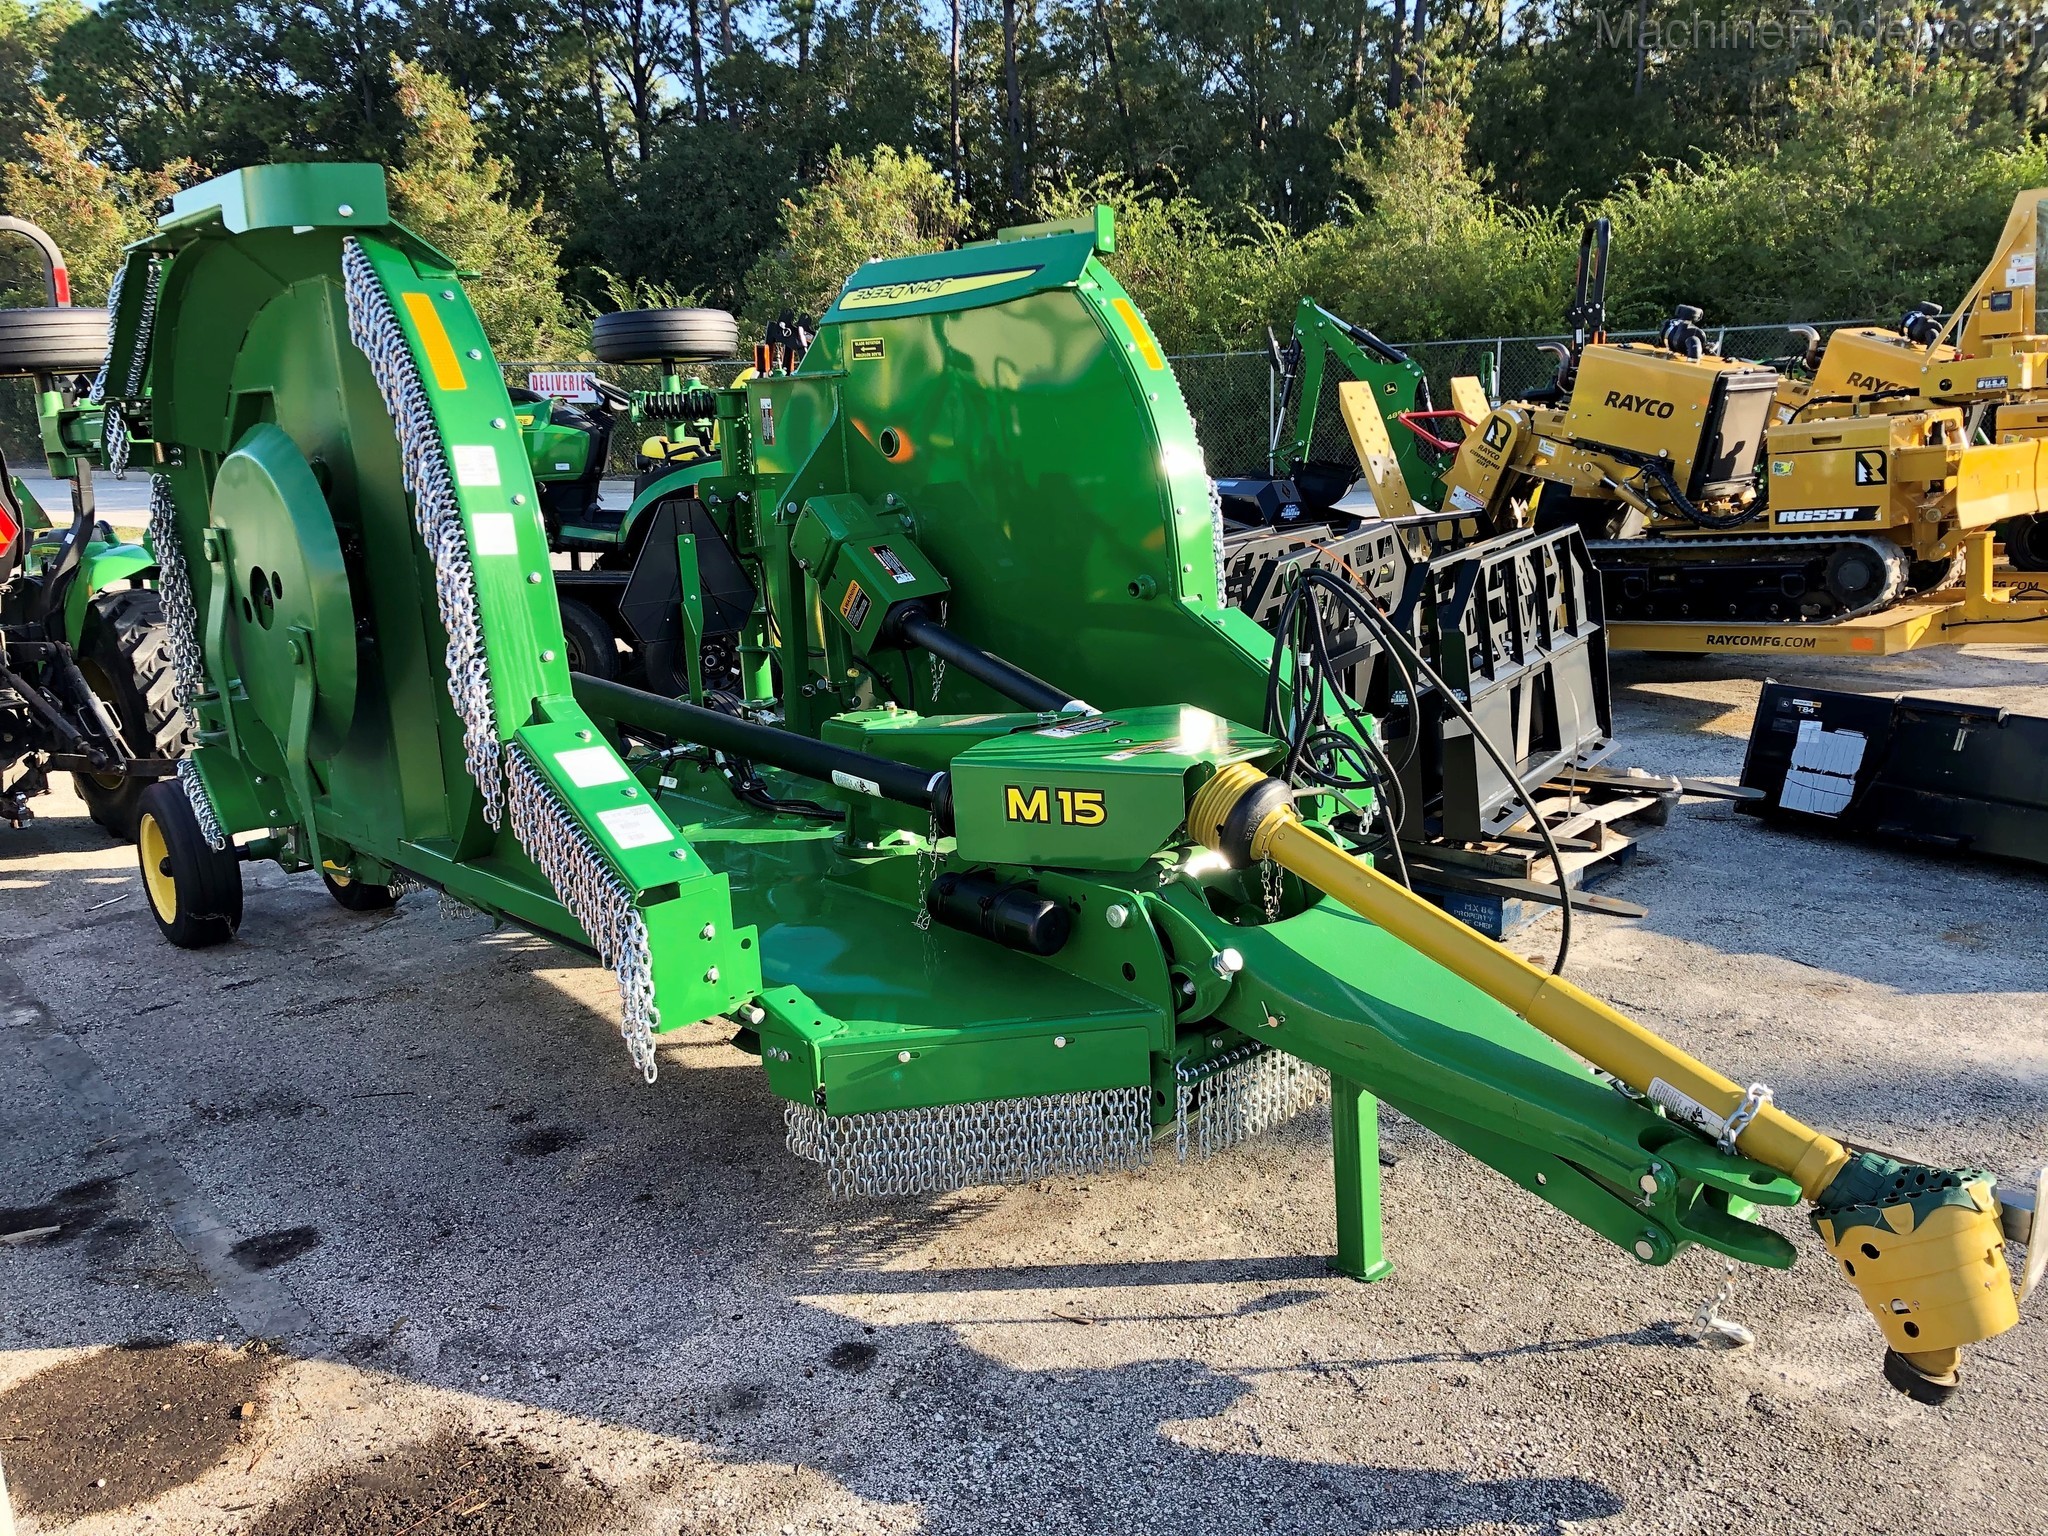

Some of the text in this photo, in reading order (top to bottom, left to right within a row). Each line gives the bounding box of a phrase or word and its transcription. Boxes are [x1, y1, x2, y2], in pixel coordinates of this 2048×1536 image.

[853, 279, 951, 301] JOHN DEERE
[1846, 371, 1909, 392] RAYC
[1604, 390, 1675, 419] RAYCO
[1469, 448, 1501, 471] COMMAND
[1477, 444, 1500, 461] RAYCO
[1778, 507, 1859, 523] RG55T
[1706, 634, 1817, 649] RAYCOMFG.COM
[1004, 784, 1108, 828] M 15
[1453, 908, 1493, 923] PROPERTY
[1473, 920, 1493, 930] CHEP
